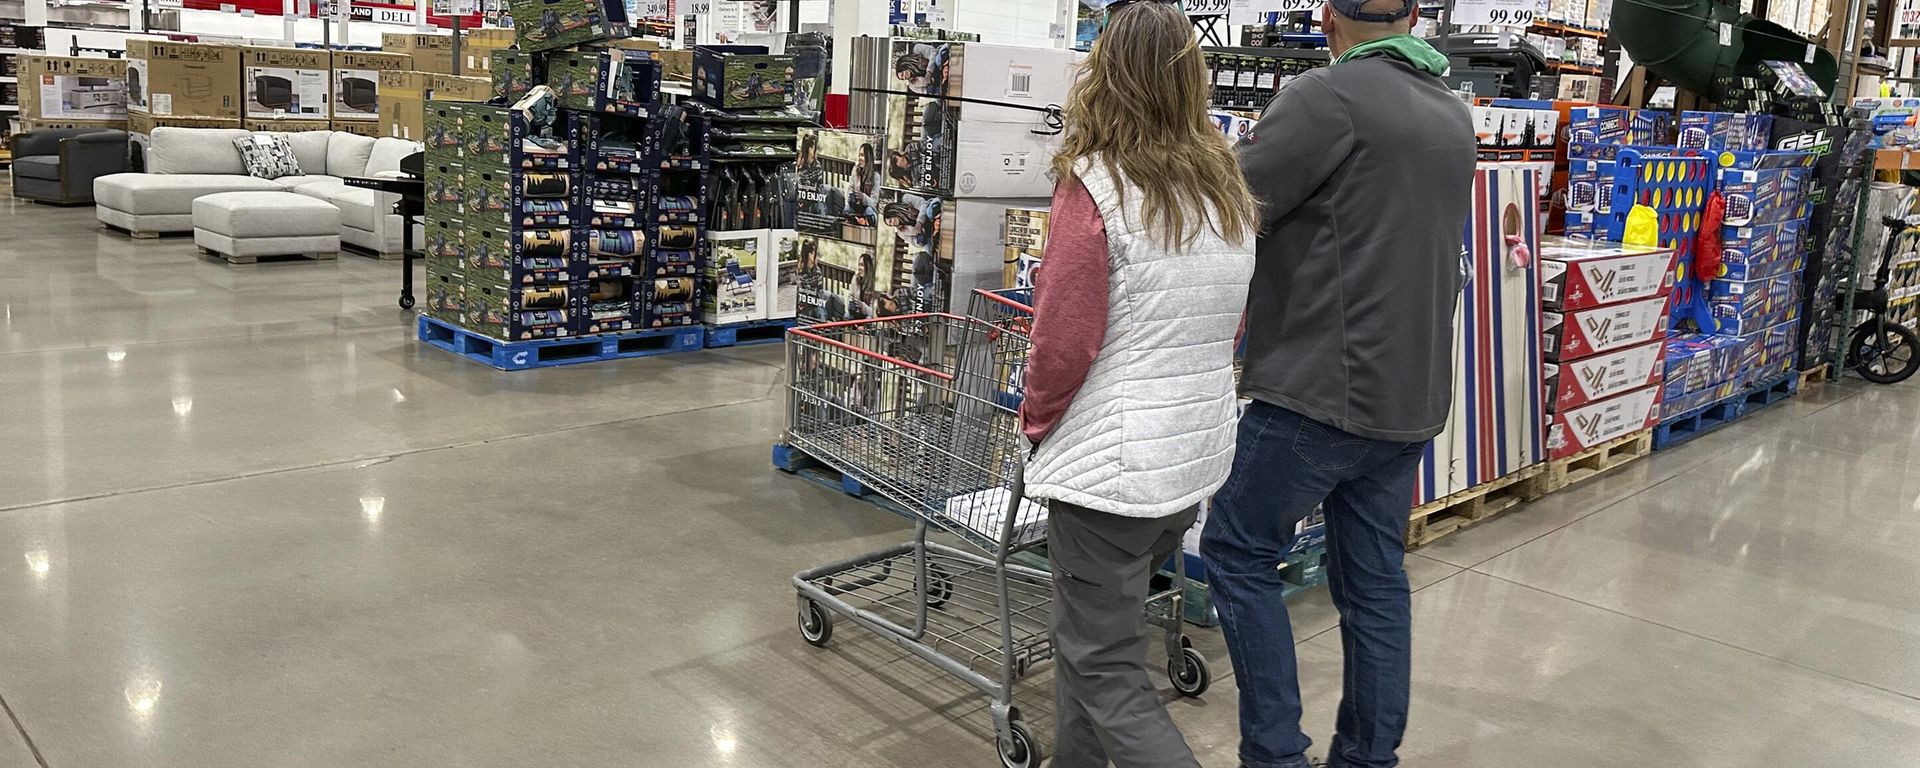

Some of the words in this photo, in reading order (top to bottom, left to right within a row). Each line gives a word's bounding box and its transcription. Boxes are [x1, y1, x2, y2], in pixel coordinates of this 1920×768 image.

[647, 4, 666, 14] 349.99
[692, 3, 709, 14] 18.99
[381, 11, 410, 22] DELI
[1489, 9, 1533, 24] 99.99
[925, 174, 932, 187] TO
[798, 190, 806, 199] TO
[807, 192, 827, 202] ENJOY
[798, 294, 806, 302] TO
[807, 295, 827, 307] ENJOY
